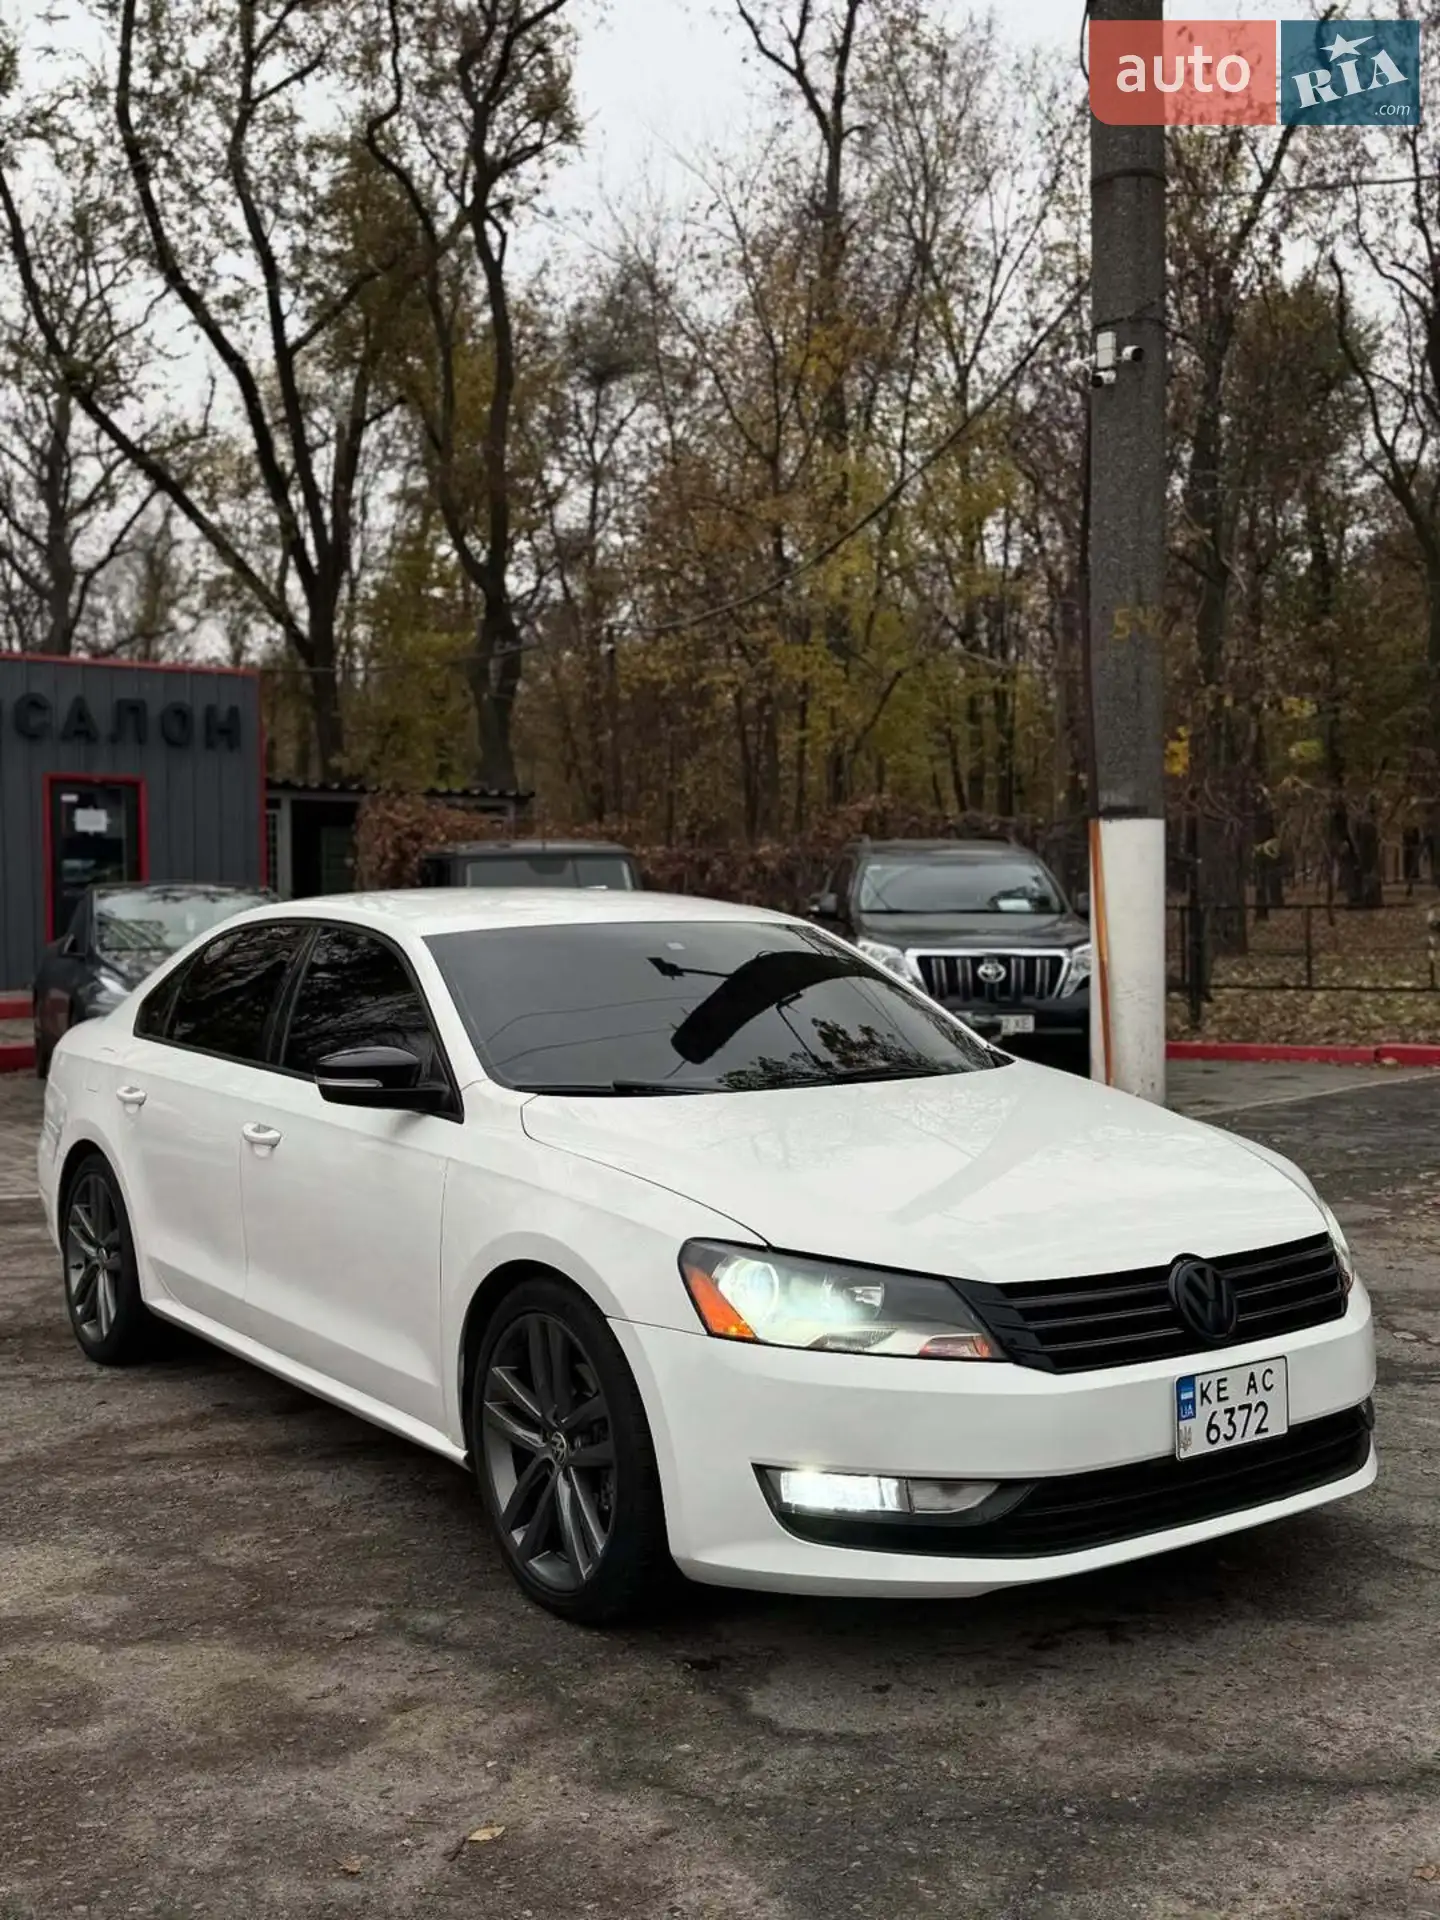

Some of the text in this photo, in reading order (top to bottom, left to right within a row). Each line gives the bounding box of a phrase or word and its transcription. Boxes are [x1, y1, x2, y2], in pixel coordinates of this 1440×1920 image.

[0, 693, 241, 753] САЛОН
[1200, 1368, 1275, 1407] KE AC
[1180, 1403, 1194, 1419] UA
[1206, 1400, 1269, 1445] 6372
